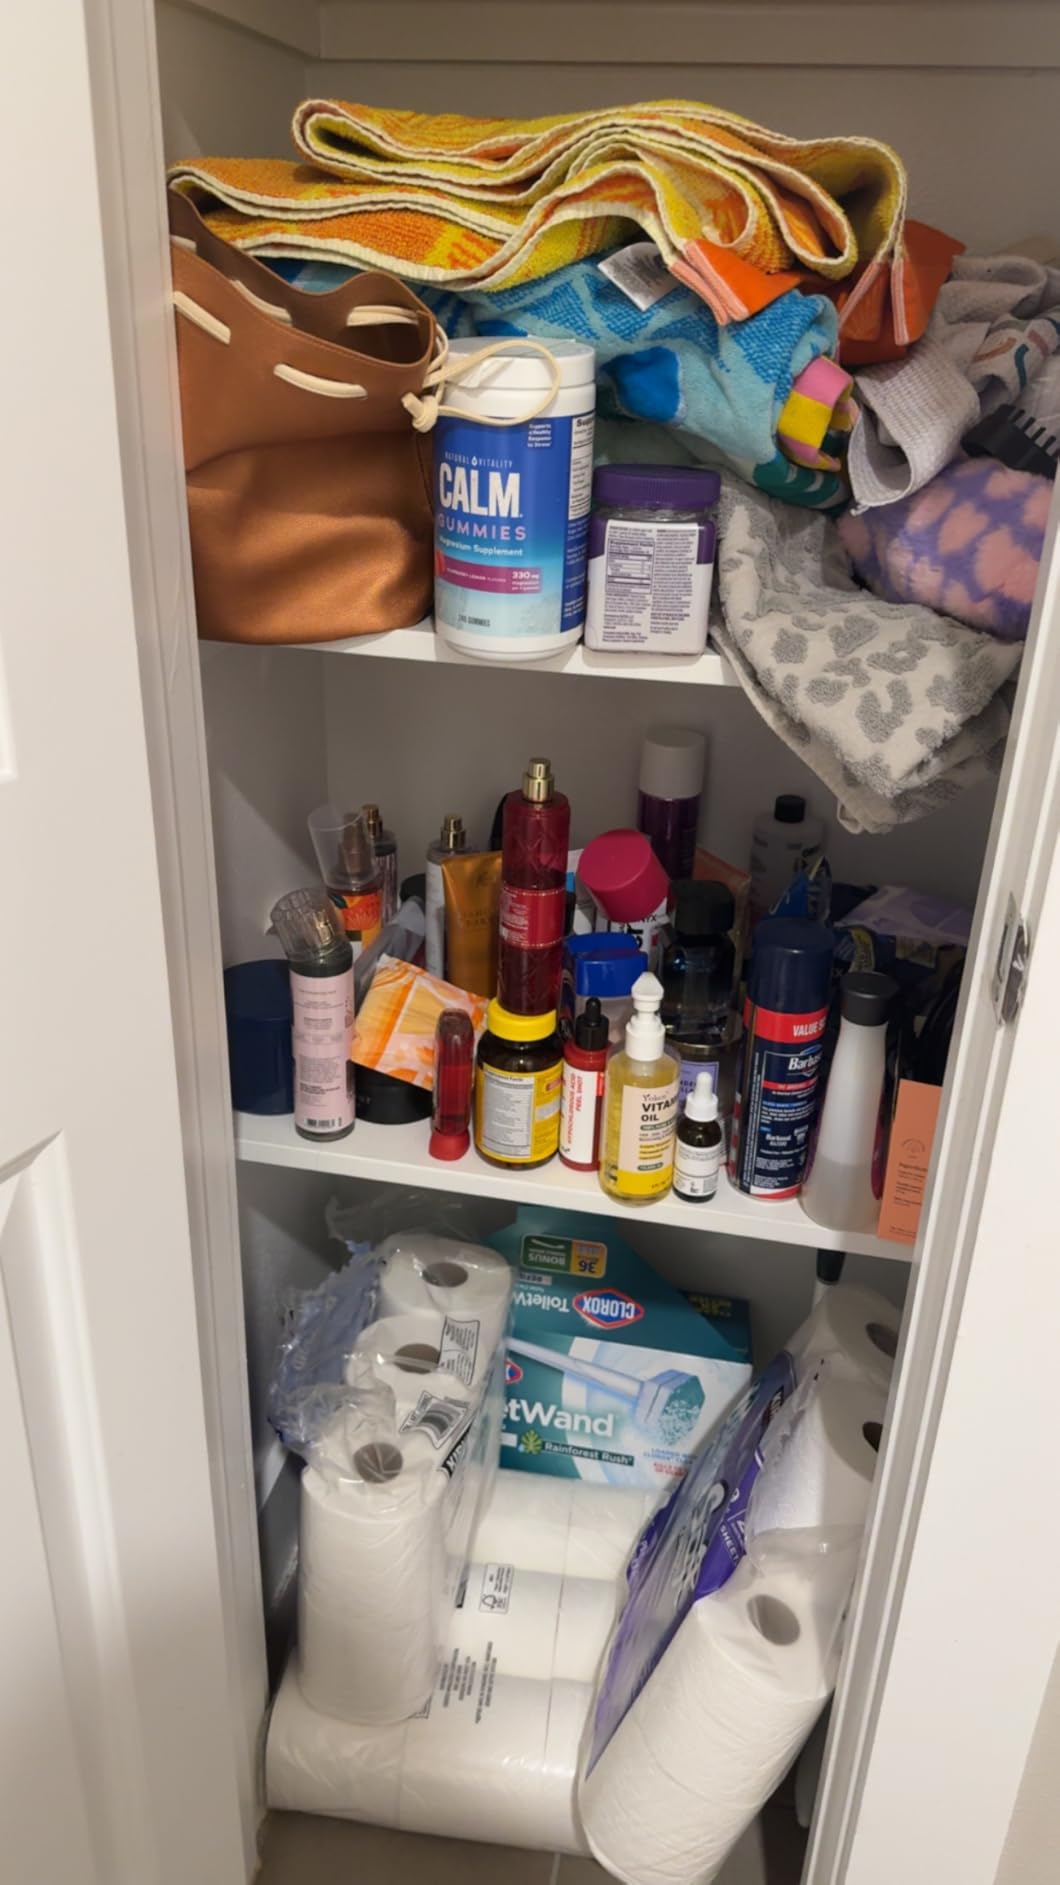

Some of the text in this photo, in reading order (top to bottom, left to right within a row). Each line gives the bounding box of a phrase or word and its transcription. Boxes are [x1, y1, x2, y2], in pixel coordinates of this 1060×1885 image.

[444, 452, 513, 468] NATURAL VITALITY
[439, 462, 521, 518] CALM
[438, 513, 527, 541] GUMMIES
[473, 544, 523, 557] Supplement
[793, 1021, 818, 1037] VALUE
[640, 1114, 660, 1122] OIL
[527, 1253, 566, 1266] BONUS
[577, 1260, 597, 1274] 36
[581, 1295, 636, 1320] CLOROX
[544, 1442, 600, 1461] Rainforest
